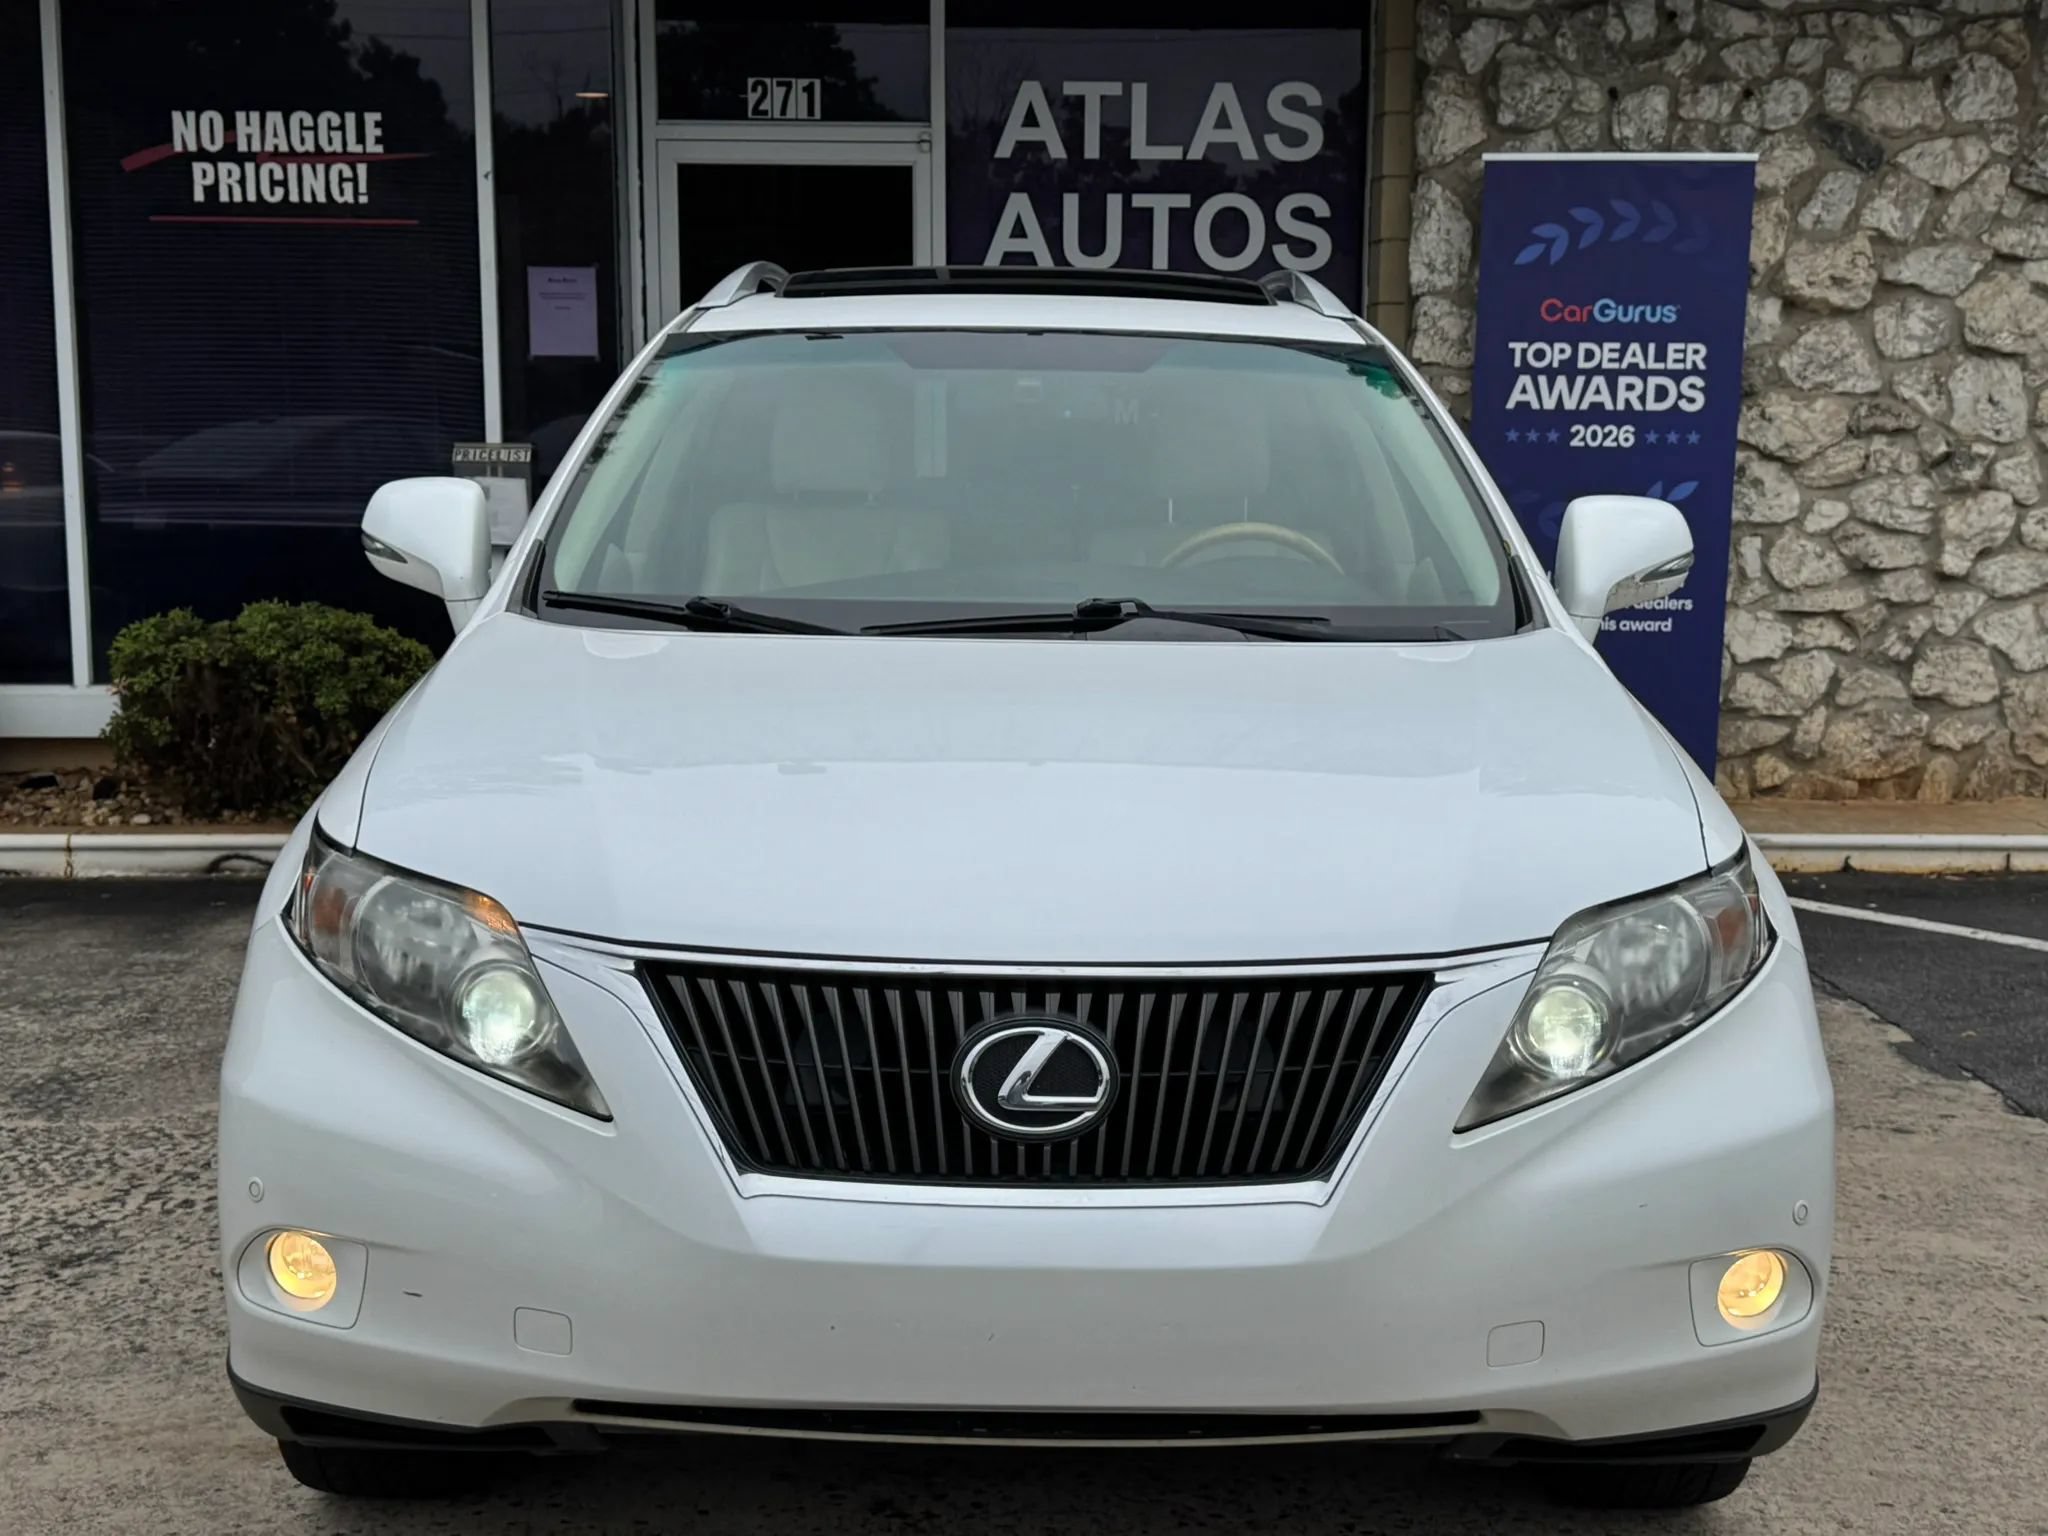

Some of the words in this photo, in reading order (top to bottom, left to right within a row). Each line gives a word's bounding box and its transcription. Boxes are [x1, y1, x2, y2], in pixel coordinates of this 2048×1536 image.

[750, 79, 816, 118] 271
[171, 109, 225, 153] NO
[235, 110, 385, 154] HAGGLE
[993, 80, 1324, 162] ATLAS
[191, 161, 369, 204] PRICING!
[982, 192, 1333, 272] AUTOS
[1540, 298, 1678, 324] CarGurus
[1508, 341, 1573, 369] TOP
[1577, 342, 1708, 371] DEALER
[1505, 374, 1706, 413] AWARDS
[1569, 424, 1636, 448] 2026
[1619, 617, 1673, 632] award
